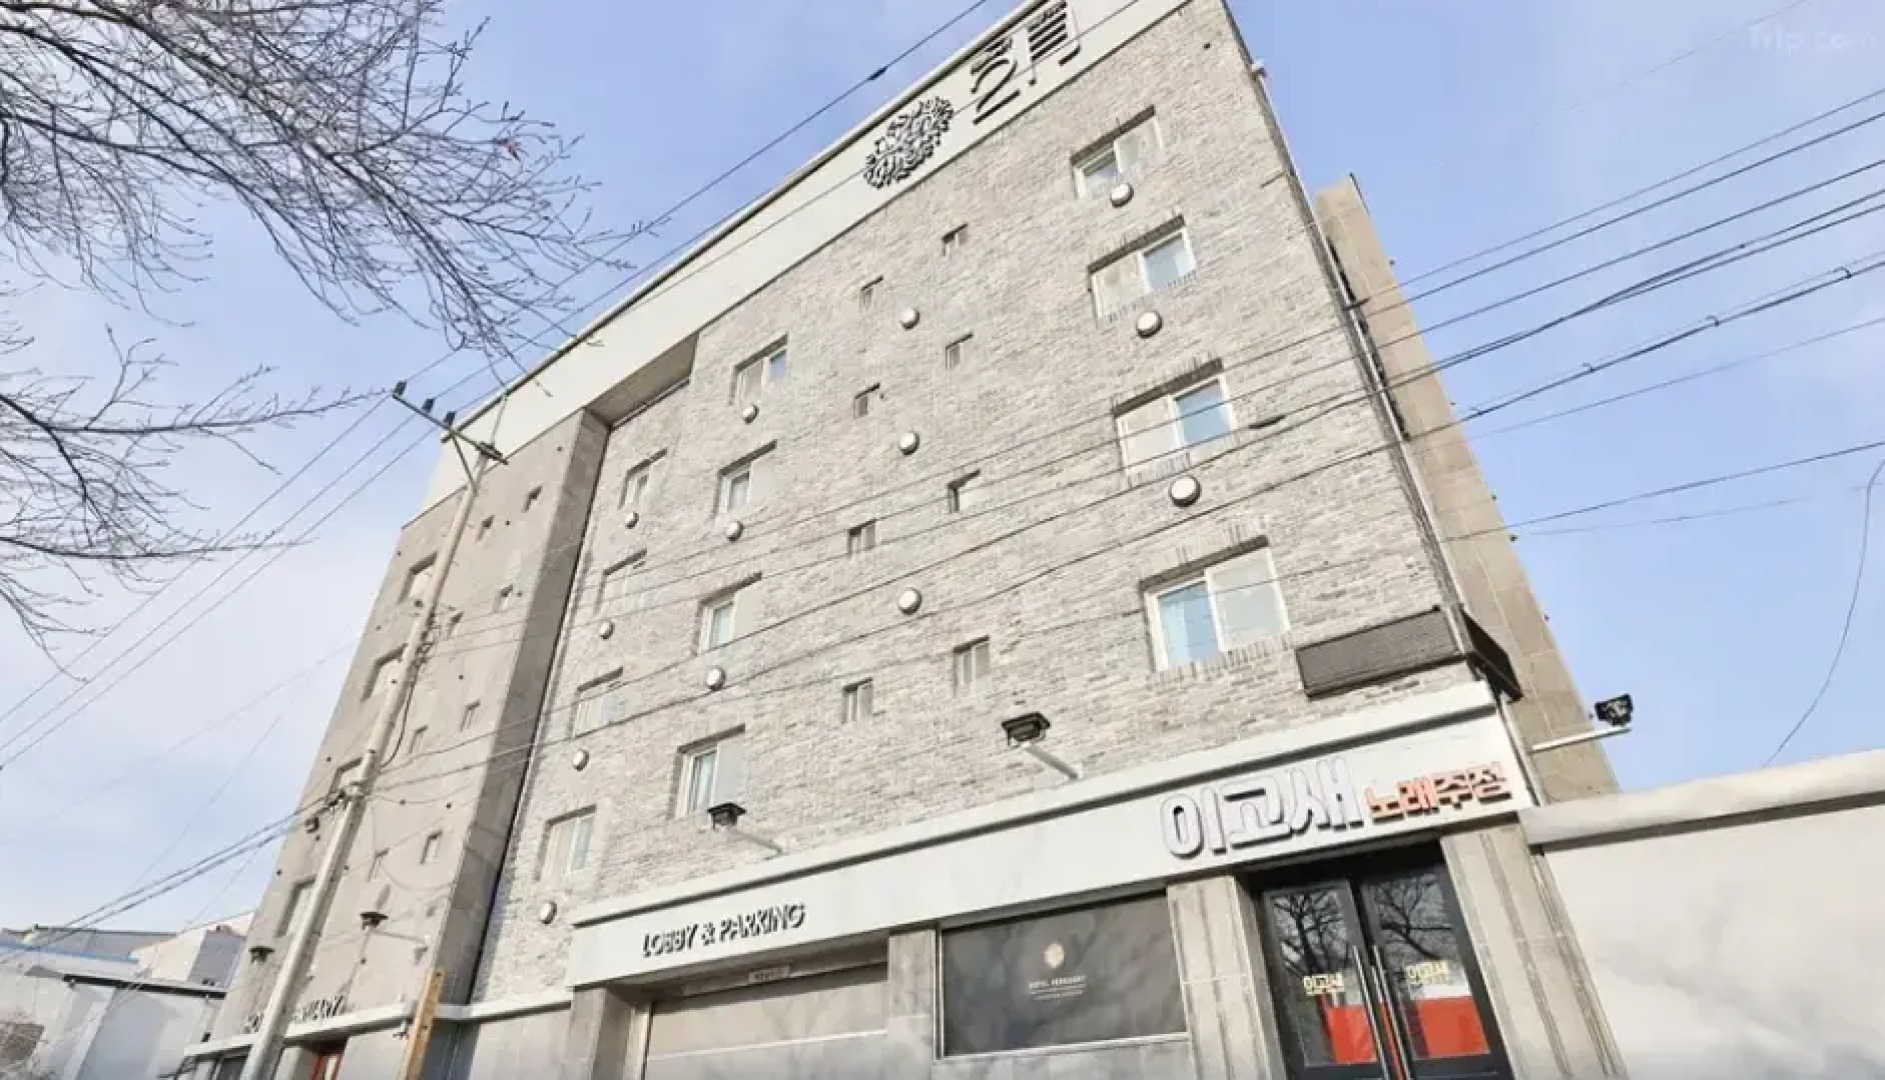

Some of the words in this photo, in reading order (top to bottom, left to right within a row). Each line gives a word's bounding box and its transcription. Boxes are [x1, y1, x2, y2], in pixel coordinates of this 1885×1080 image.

[1365, 762, 1512, 822] 노래주점
[643, 923, 699, 958] LOBBY
[701, 921, 716, 946] &
[719, 902, 807, 942] PARKING
